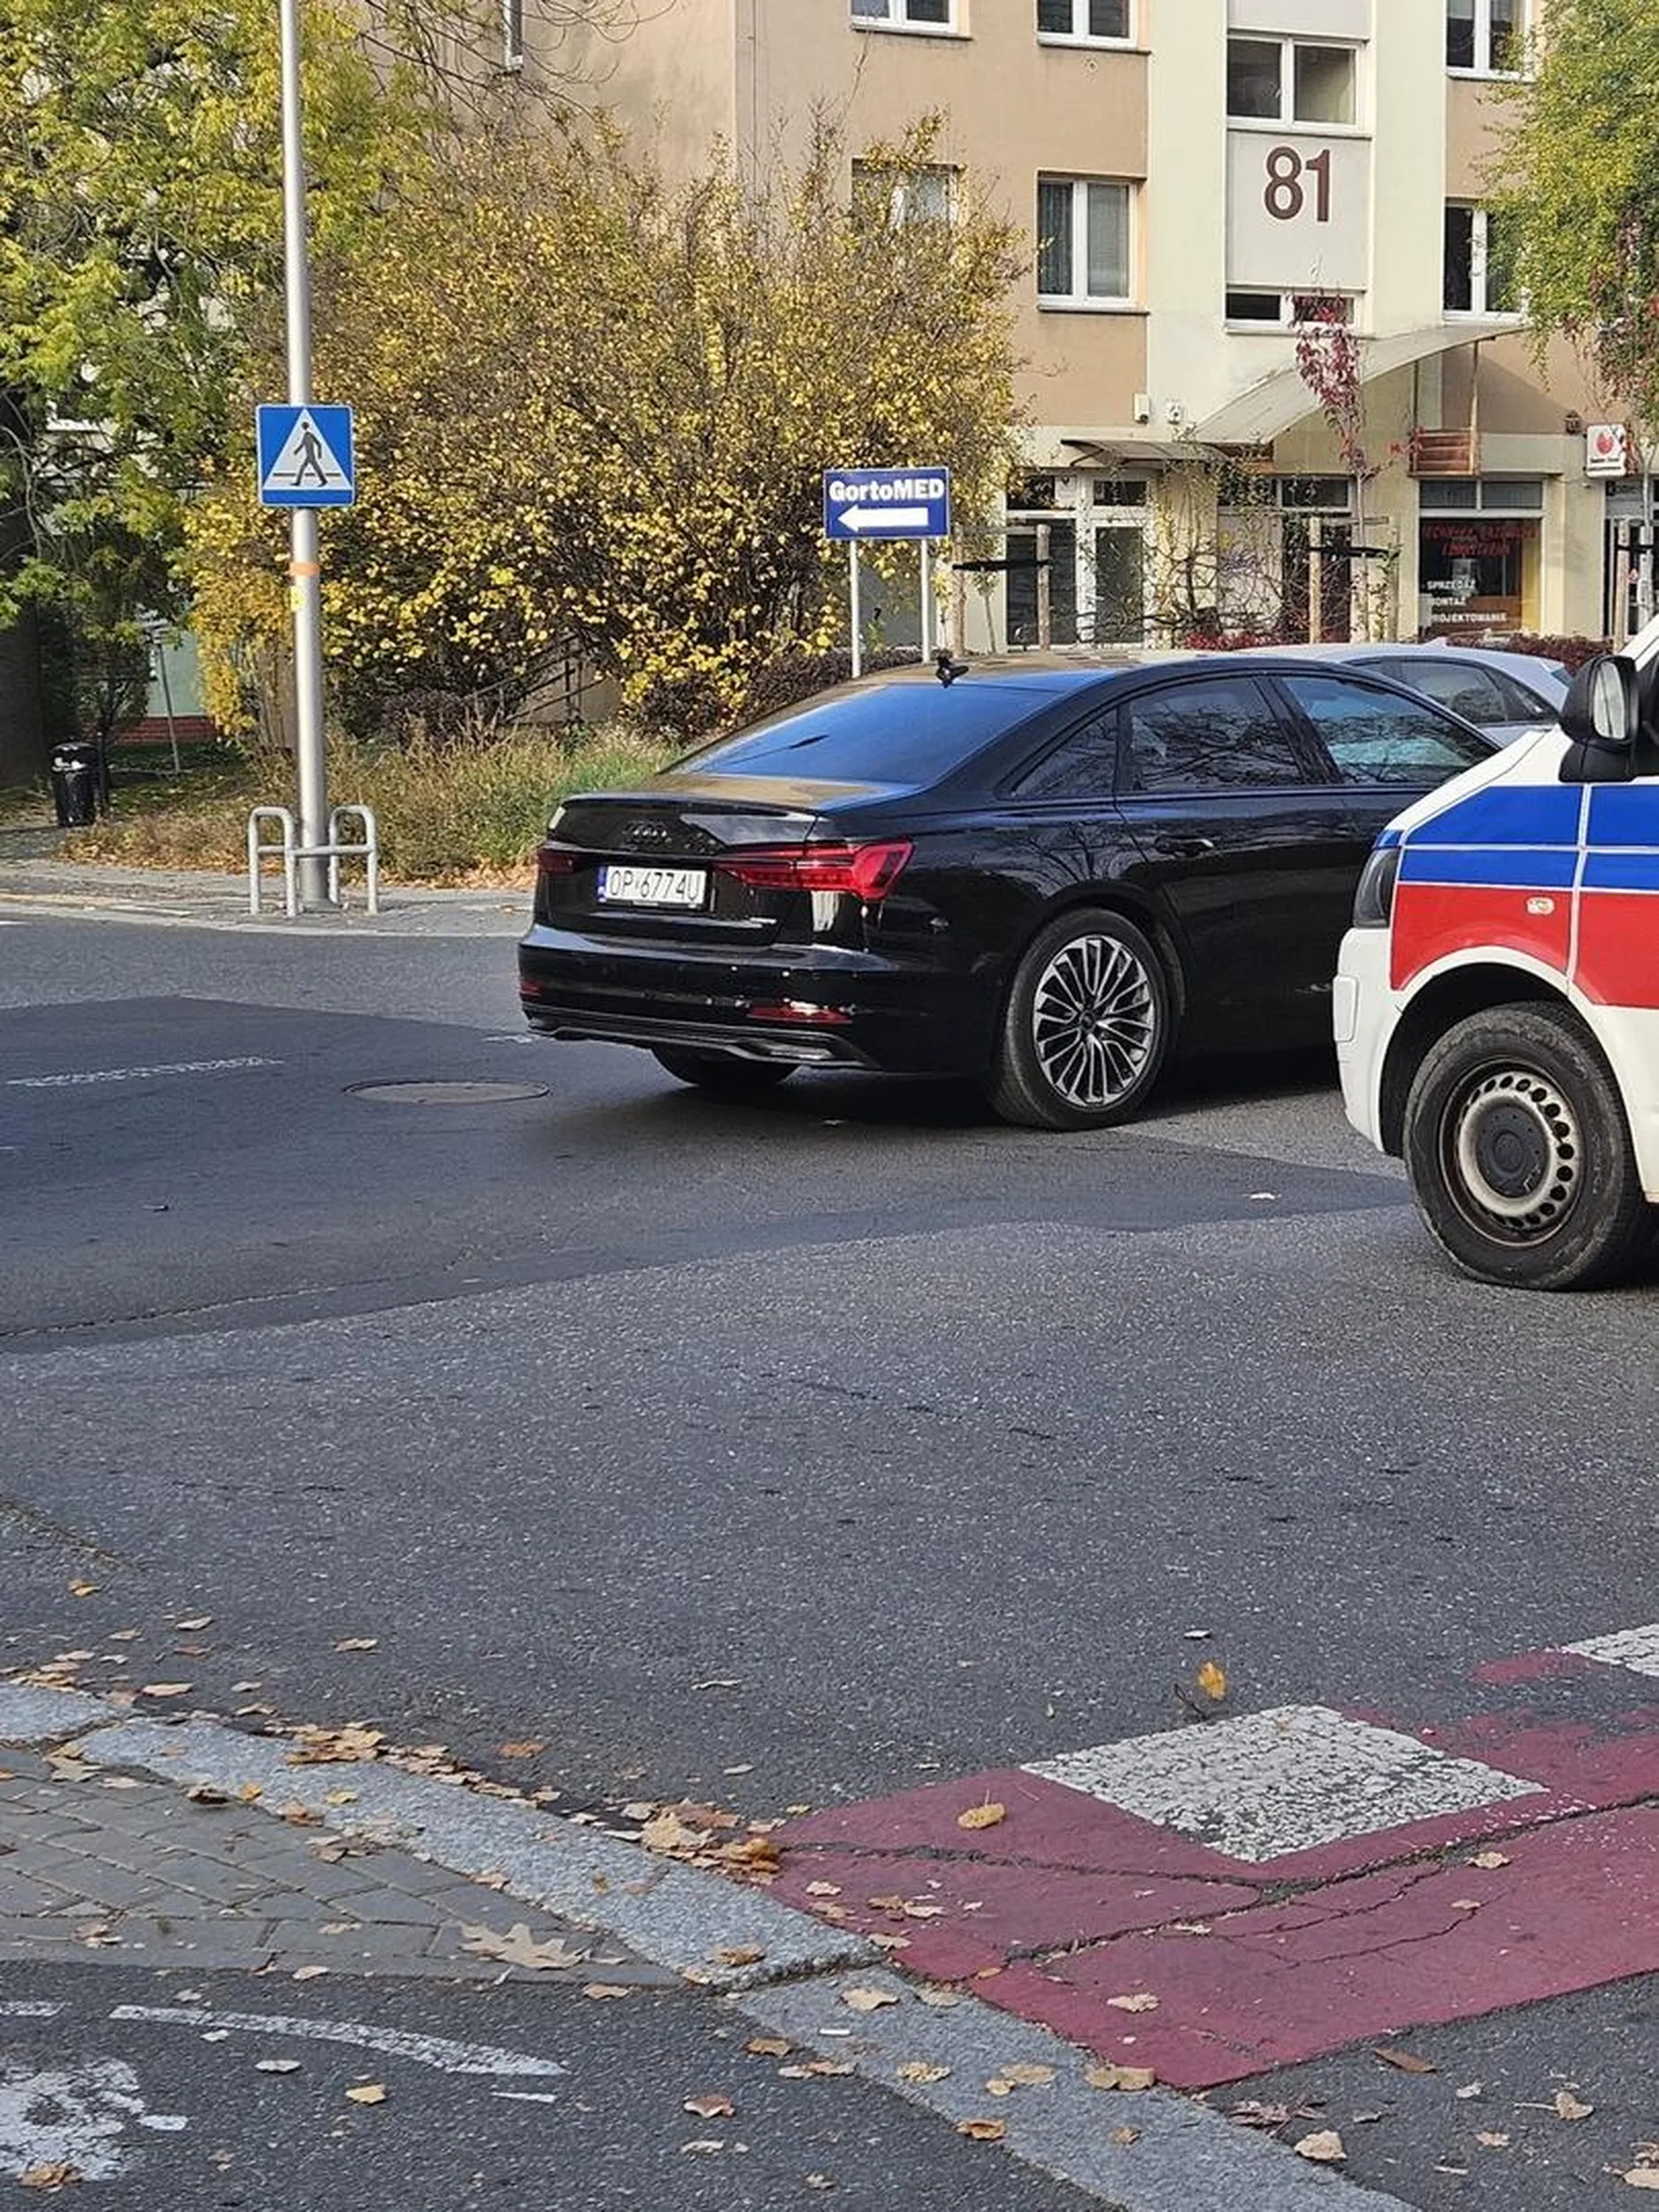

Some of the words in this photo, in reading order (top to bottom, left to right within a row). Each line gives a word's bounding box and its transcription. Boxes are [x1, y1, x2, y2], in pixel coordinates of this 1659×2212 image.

[1263, 145, 1330, 222] 81
[828, 478, 945, 502] GortoMED
[640, 871, 702, 901] 6774U
